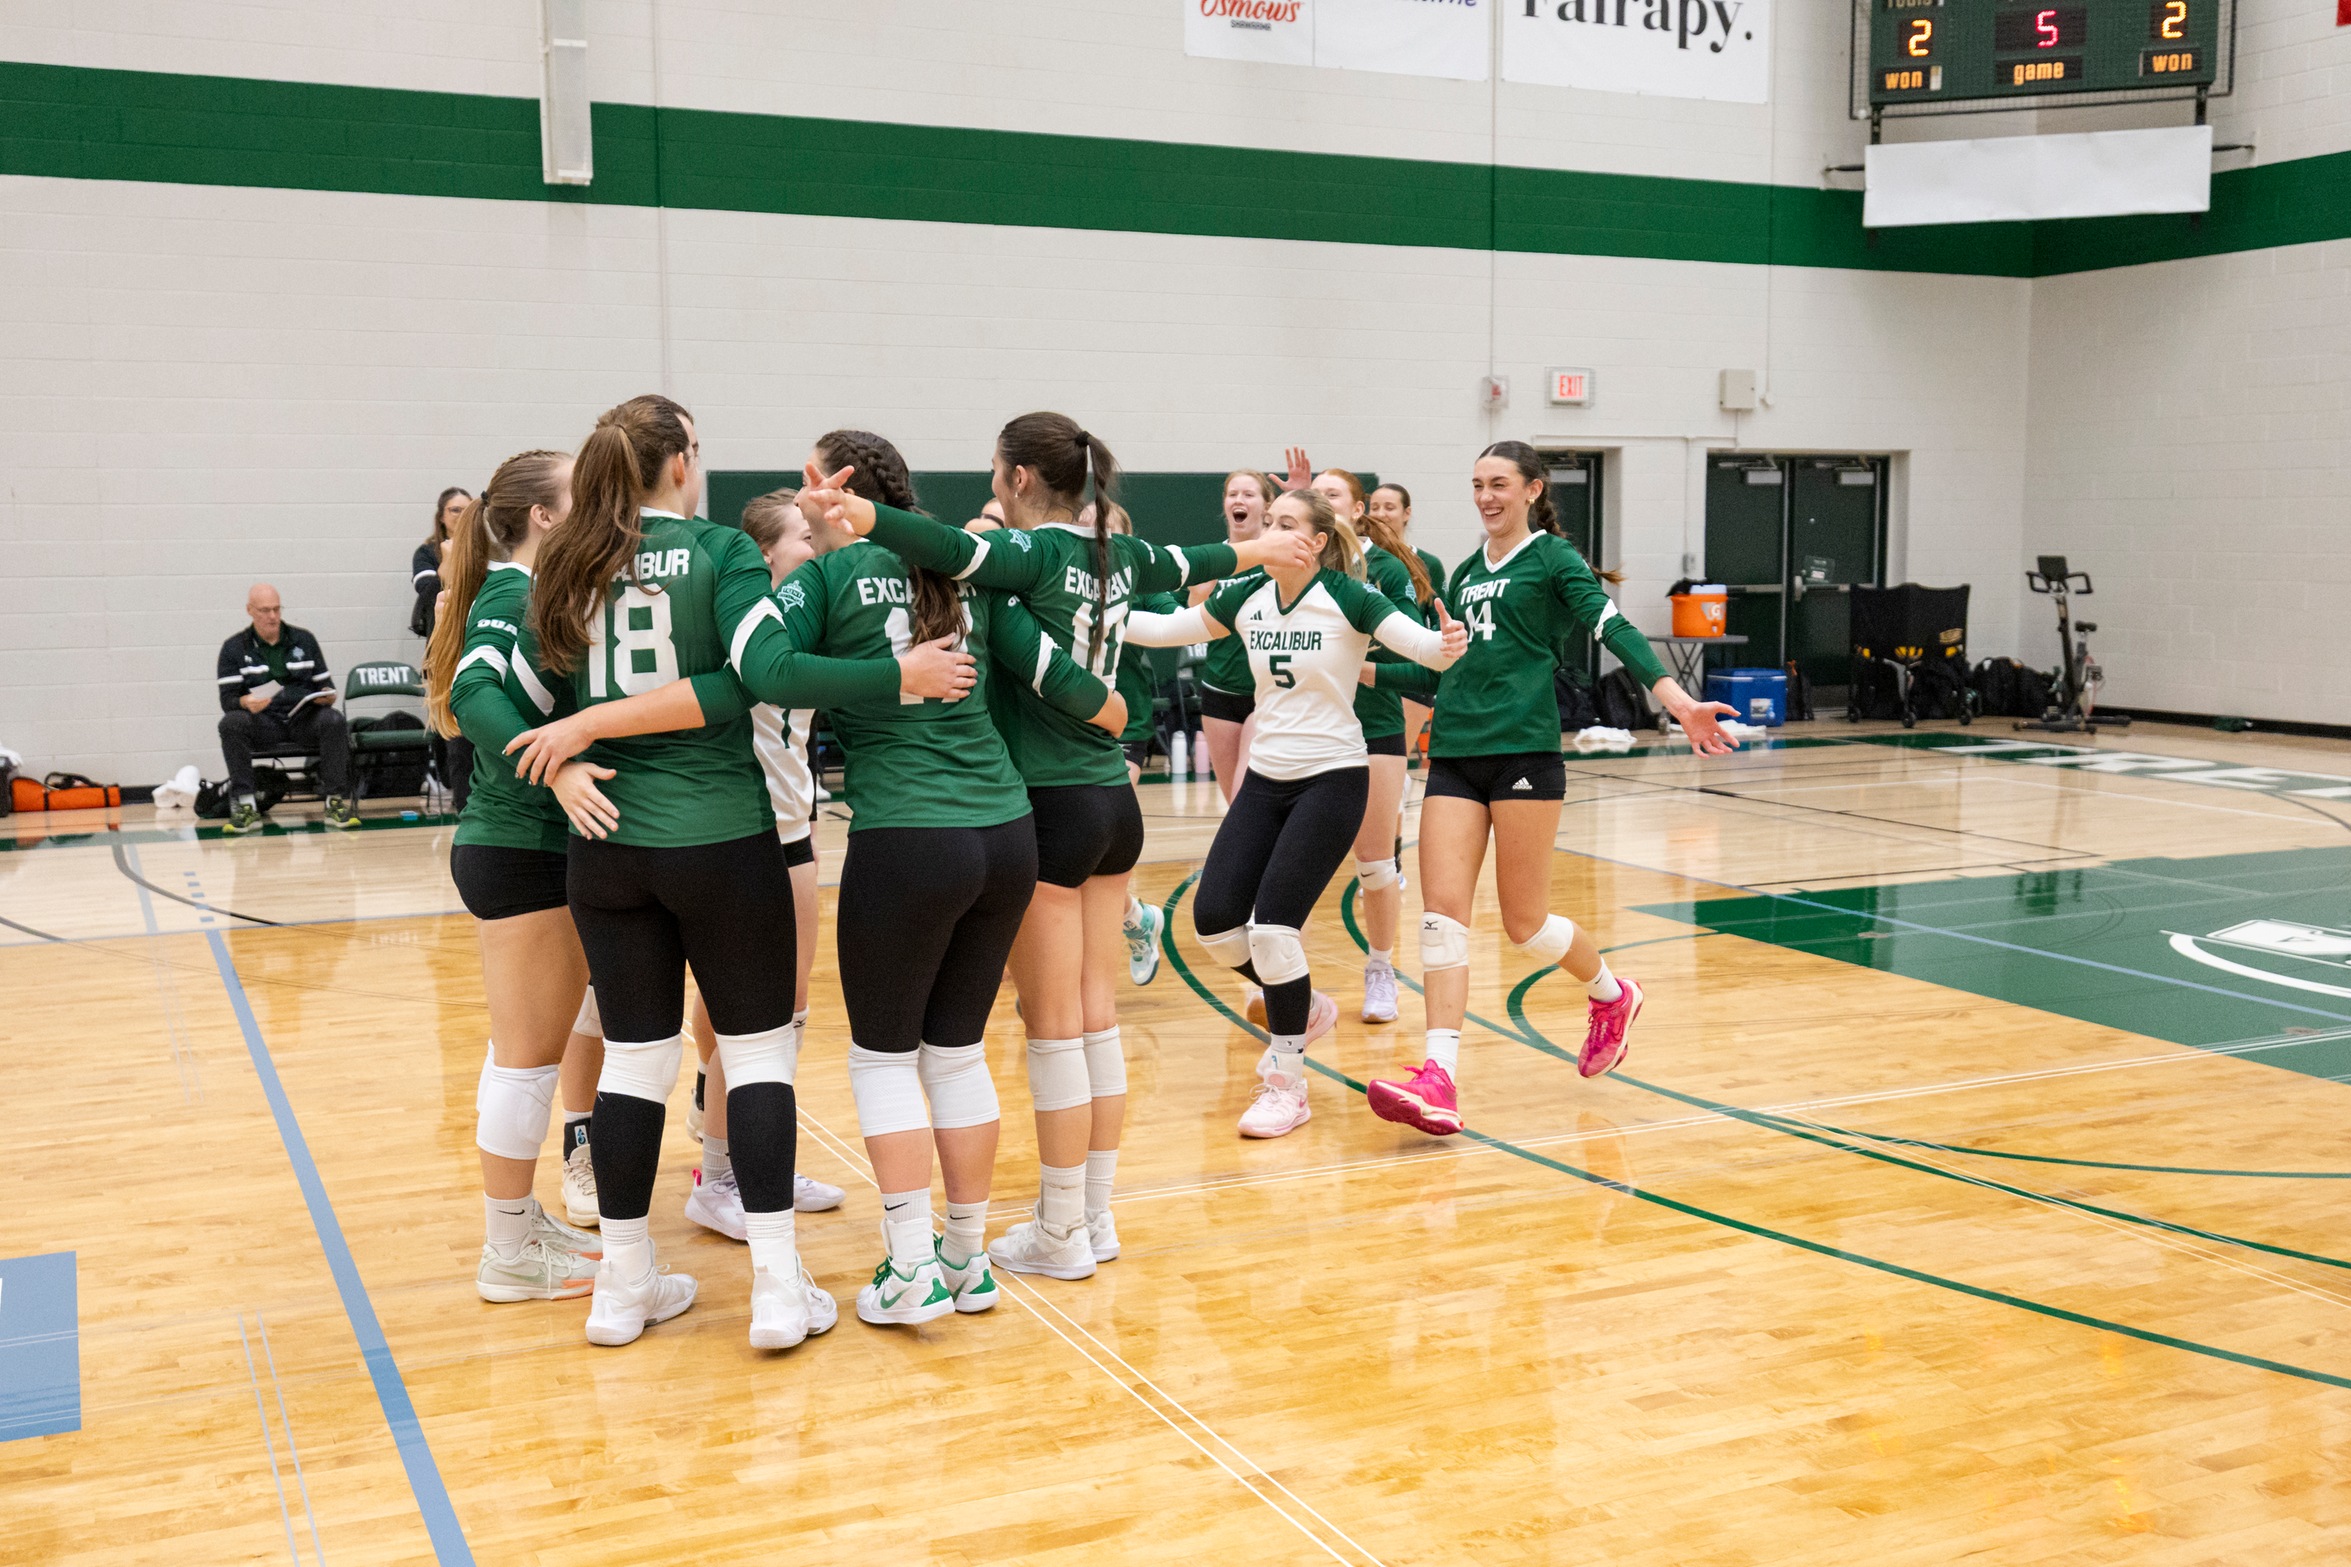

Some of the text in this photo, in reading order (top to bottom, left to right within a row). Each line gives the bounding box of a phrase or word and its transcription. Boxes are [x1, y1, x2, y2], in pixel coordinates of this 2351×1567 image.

[2035, 10, 2059, 48] 5
[2161, 1, 2187, 39] 2
[1908, 19, 1932, 56] 2
[2013, 62, 2065, 86] game
[2152, 52, 2193, 73] won
[1885, 70, 1923, 90] won
[1559, 375, 1584, 397] EXIT
[1460, 578, 1511, 606] TRENT
[1465, 600, 1497, 643] 14
[1711, 604, 1721, 617] G
[584, 582, 680, 698] 18
[1071, 601, 1129, 692] 10
[1250, 630, 1323, 651] EXCALIBUR
[355, 666, 410, 685] TRENT
[1269, 654, 1296, 690] 5
[1928, 738, 2351, 799] TRE
